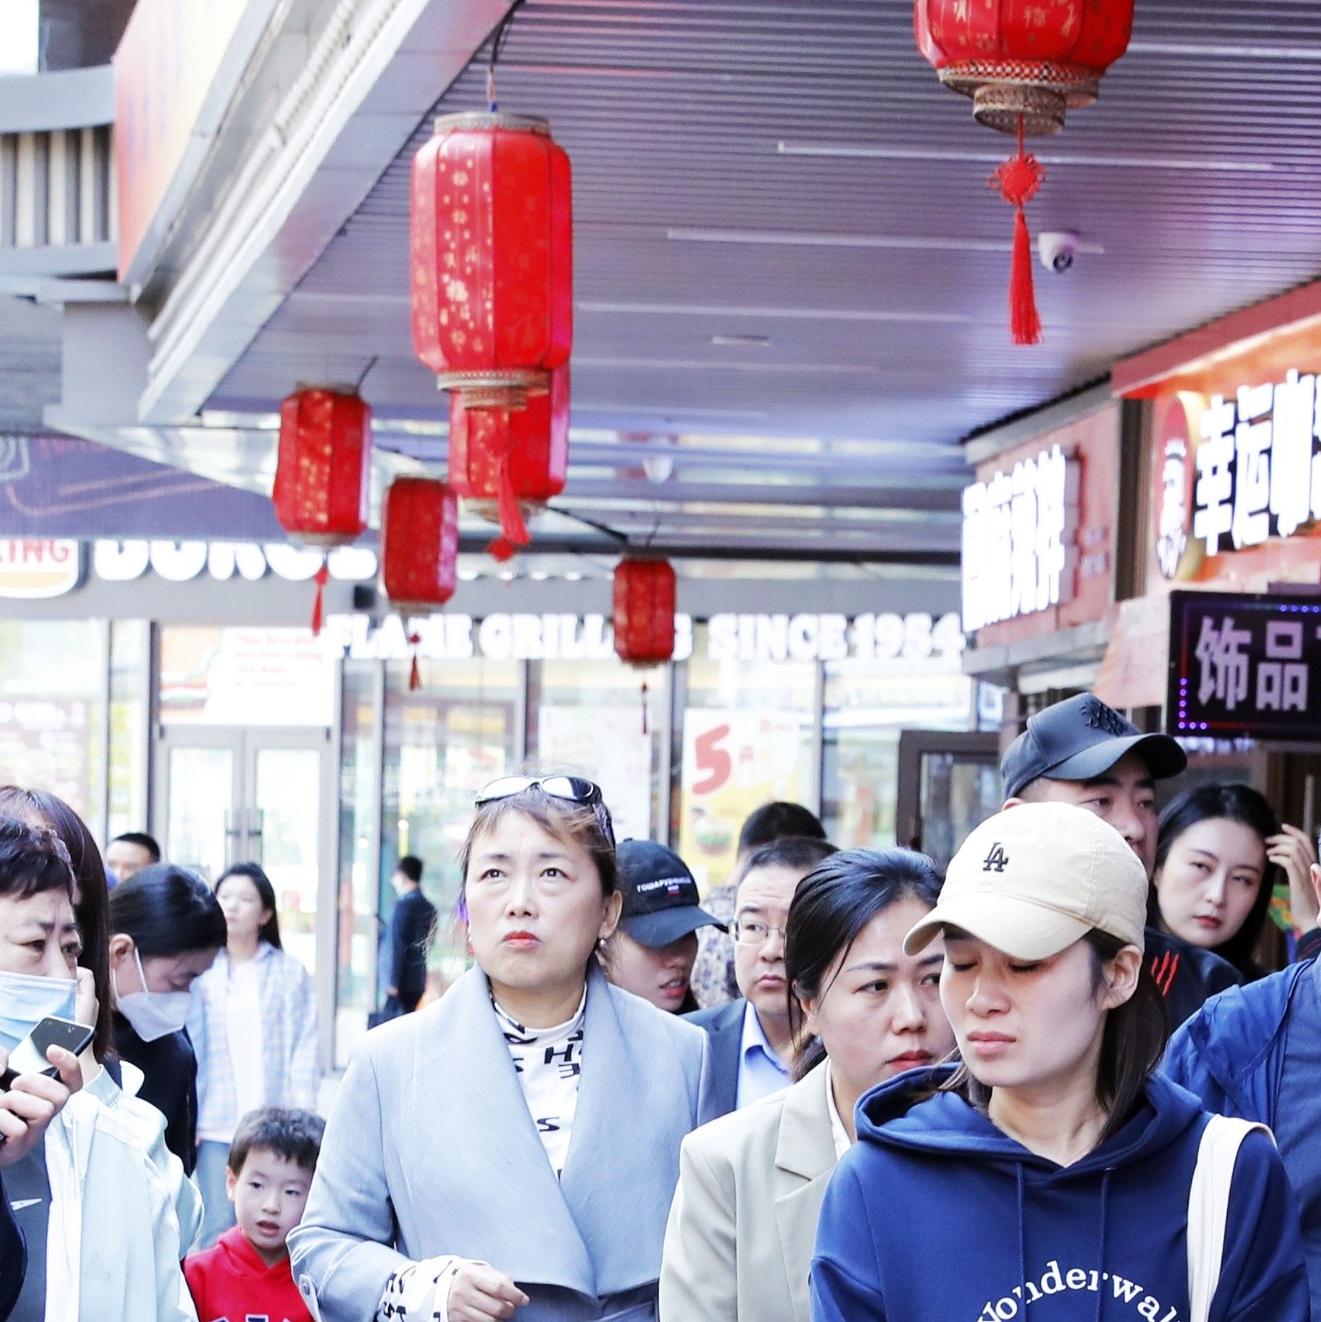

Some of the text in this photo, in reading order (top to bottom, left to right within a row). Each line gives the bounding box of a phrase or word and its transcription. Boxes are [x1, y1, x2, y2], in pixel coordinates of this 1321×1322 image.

[707, 612, 848, 661] SINCE
[851, 611, 967, 661] 1954
[1195, 615, 1310, 713] 饰品
[692, 724, 732, 795] 5
